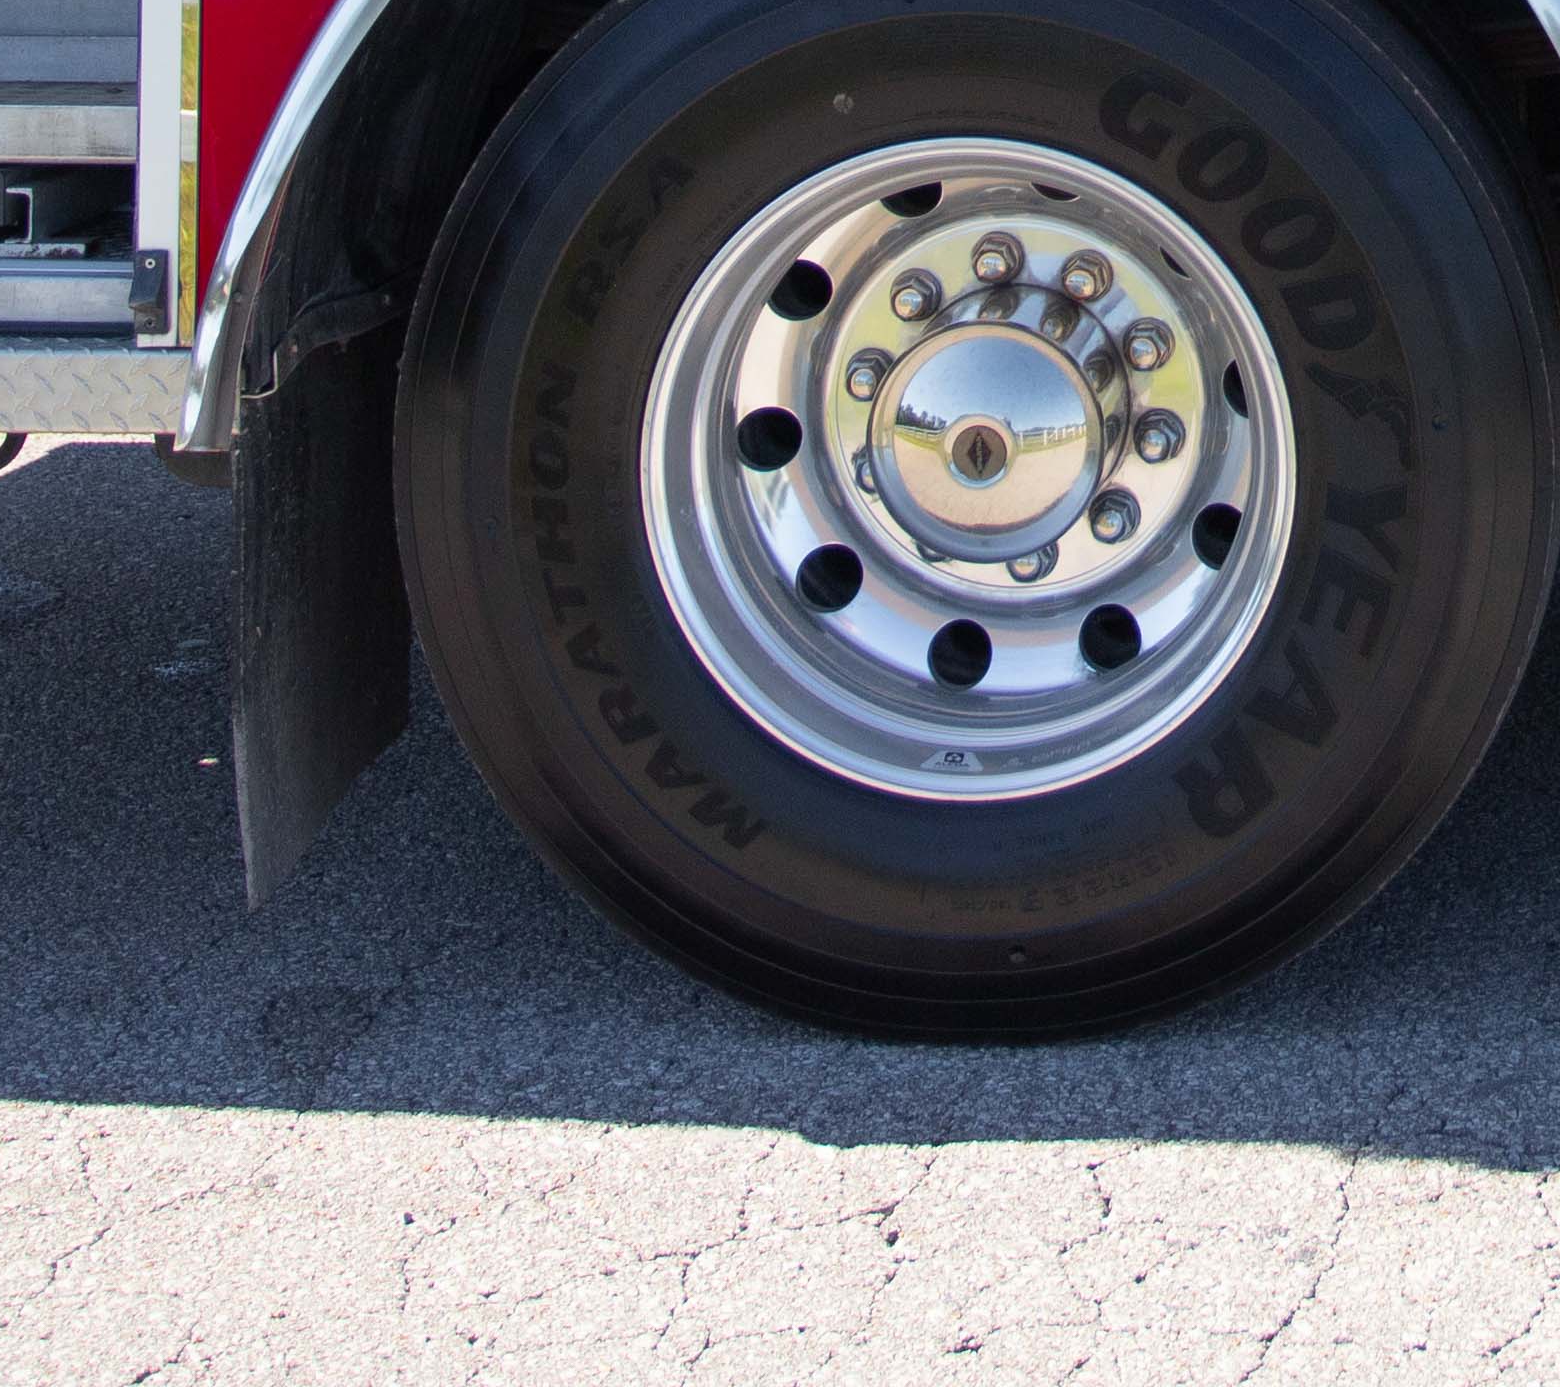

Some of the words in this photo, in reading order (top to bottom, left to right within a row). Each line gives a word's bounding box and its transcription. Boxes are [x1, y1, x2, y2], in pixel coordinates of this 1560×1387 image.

[561, 154, 697, 326] RSA
[1098, 71, 1409, 839] GOODYEAR
[528, 358, 770, 851] MARATHON
